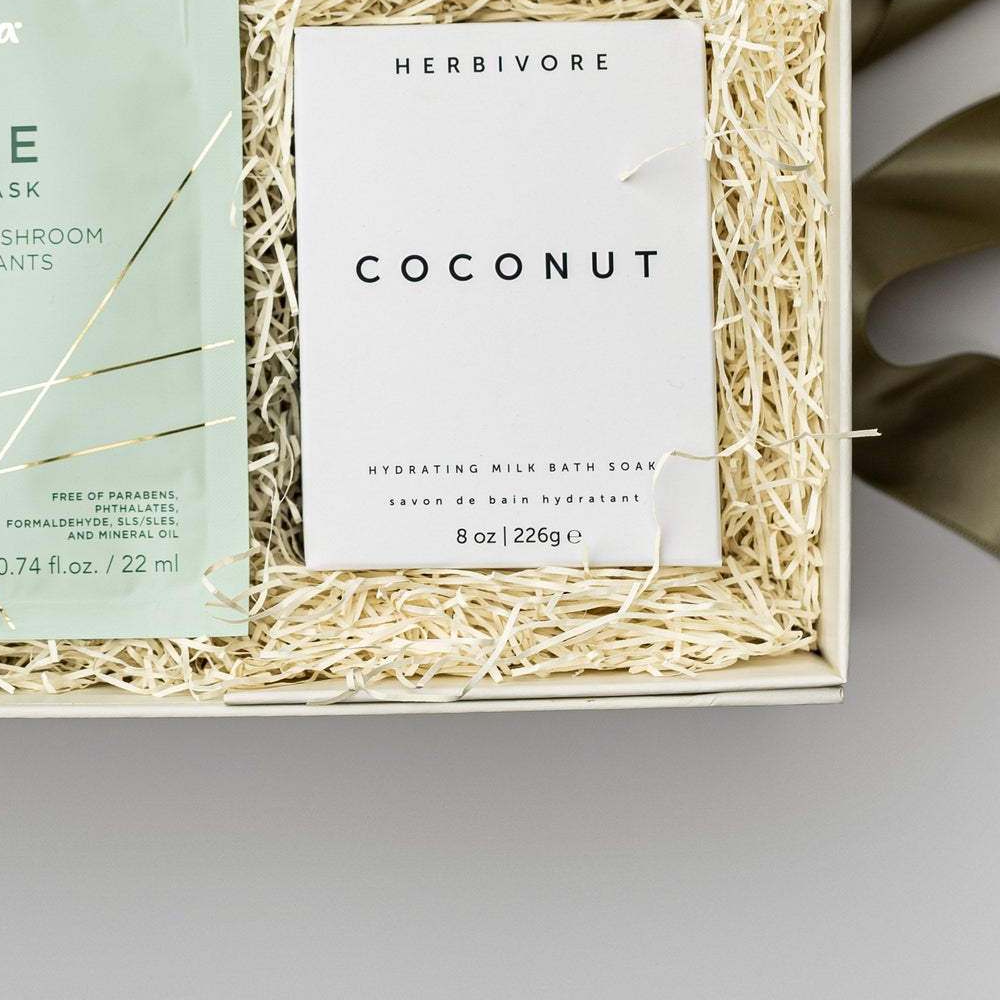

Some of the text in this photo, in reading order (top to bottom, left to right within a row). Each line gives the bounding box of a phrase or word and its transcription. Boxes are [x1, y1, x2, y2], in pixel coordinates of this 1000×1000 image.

[395, 53, 608, 75] HERBIVORE
[355, 250, 658, 284] COCONUT
[368, 461, 656, 475] HYDRATING MILK BATH SOAK
[51, 490, 179, 502] FREE OF PARABENS,
[389, 493, 641, 506] savon de bain hydratant
[95, 503, 179, 514] PHTHALATES,
[6, 515, 179, 529] FORMALDEHYDE, SLS/SLES,
[67, 529, 179, 541] AND MINERAL OIL
[456, 528, 468, 545] 8
[473, 530, 497, 545] oz
[513, 526, 561, 548] 226g
[48, 554, 98, 575] fl.oz.
[105, 554, 115, 575] /
[121, 554, 147, 574] 22
[154, 552, 179, 573] ml
